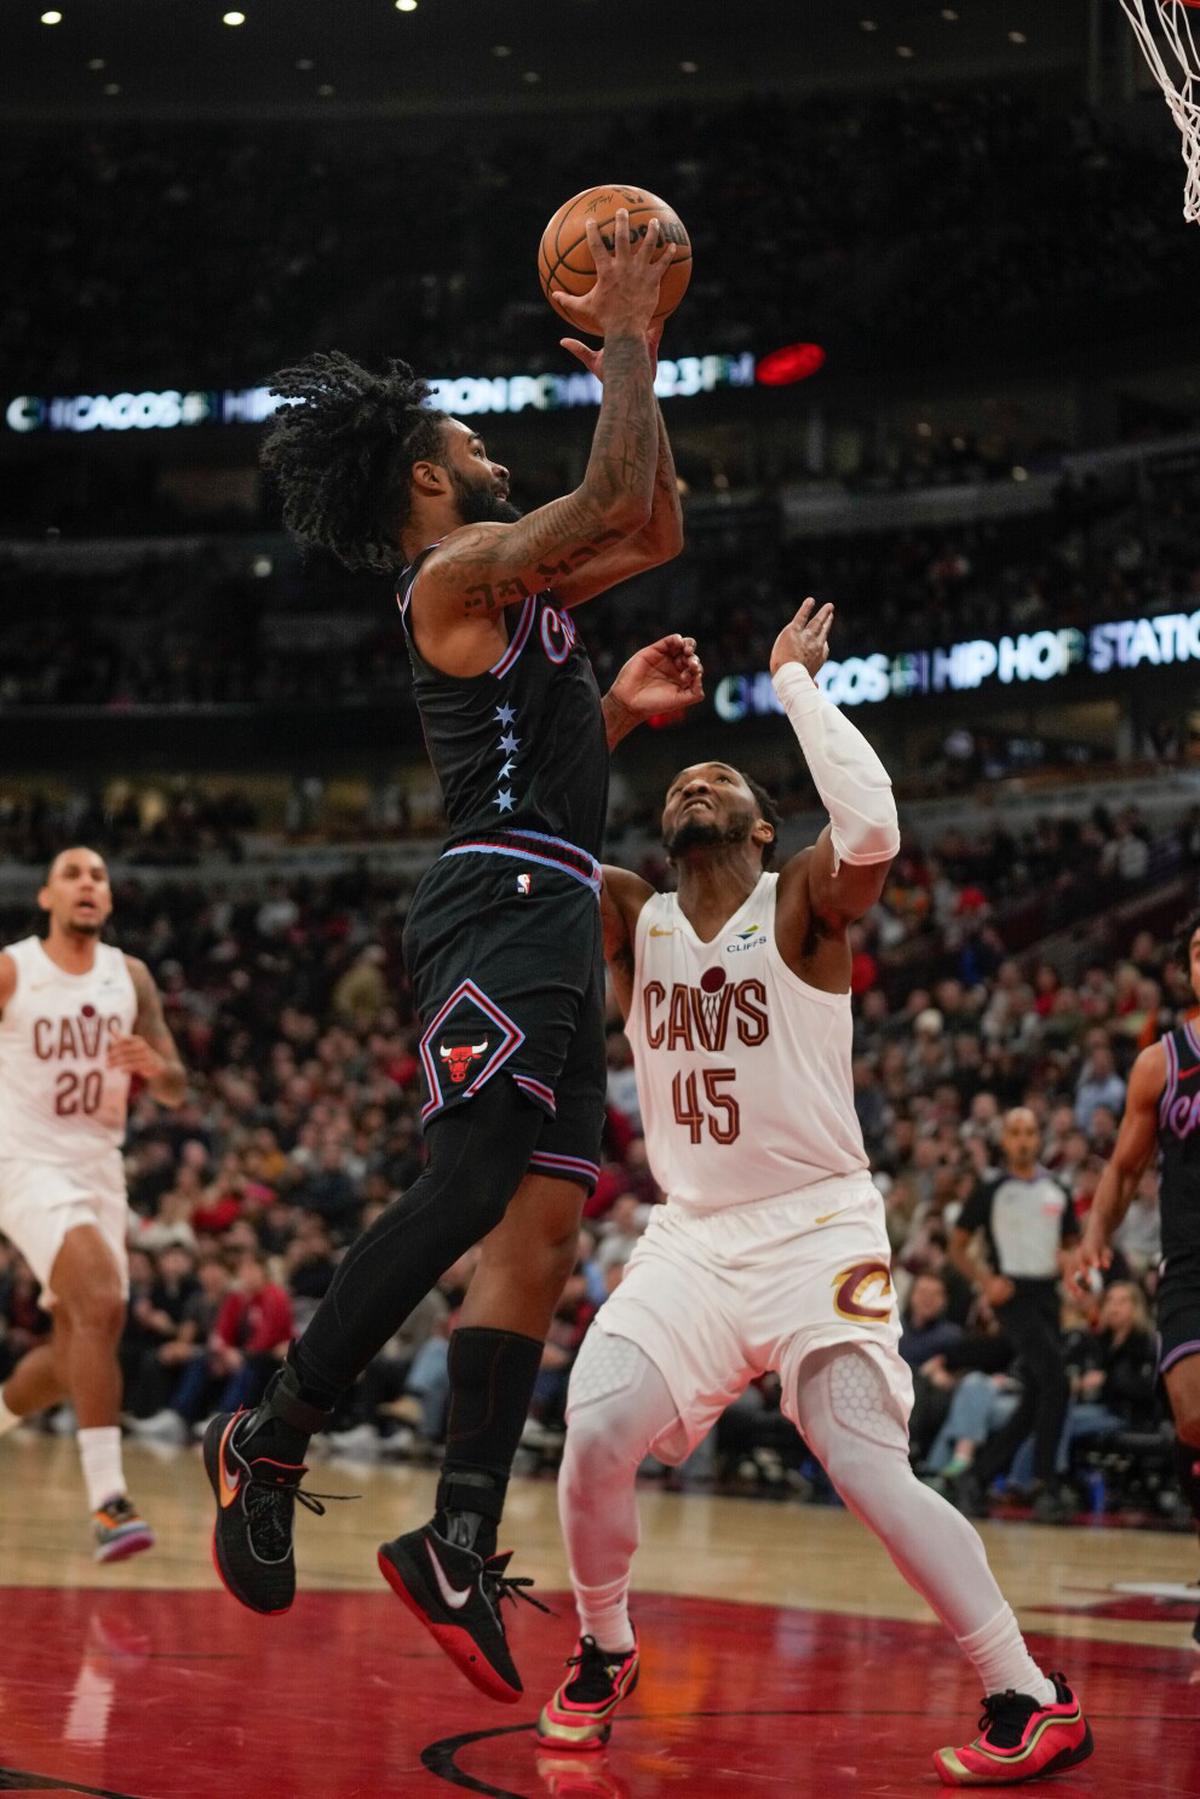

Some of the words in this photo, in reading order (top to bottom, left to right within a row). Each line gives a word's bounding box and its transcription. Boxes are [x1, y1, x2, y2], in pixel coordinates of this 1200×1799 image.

[643, 978, 769, 1051] CAVS
[55, 1069, 103, 1116] 20
[672, 1068, 741, 1145] 45
